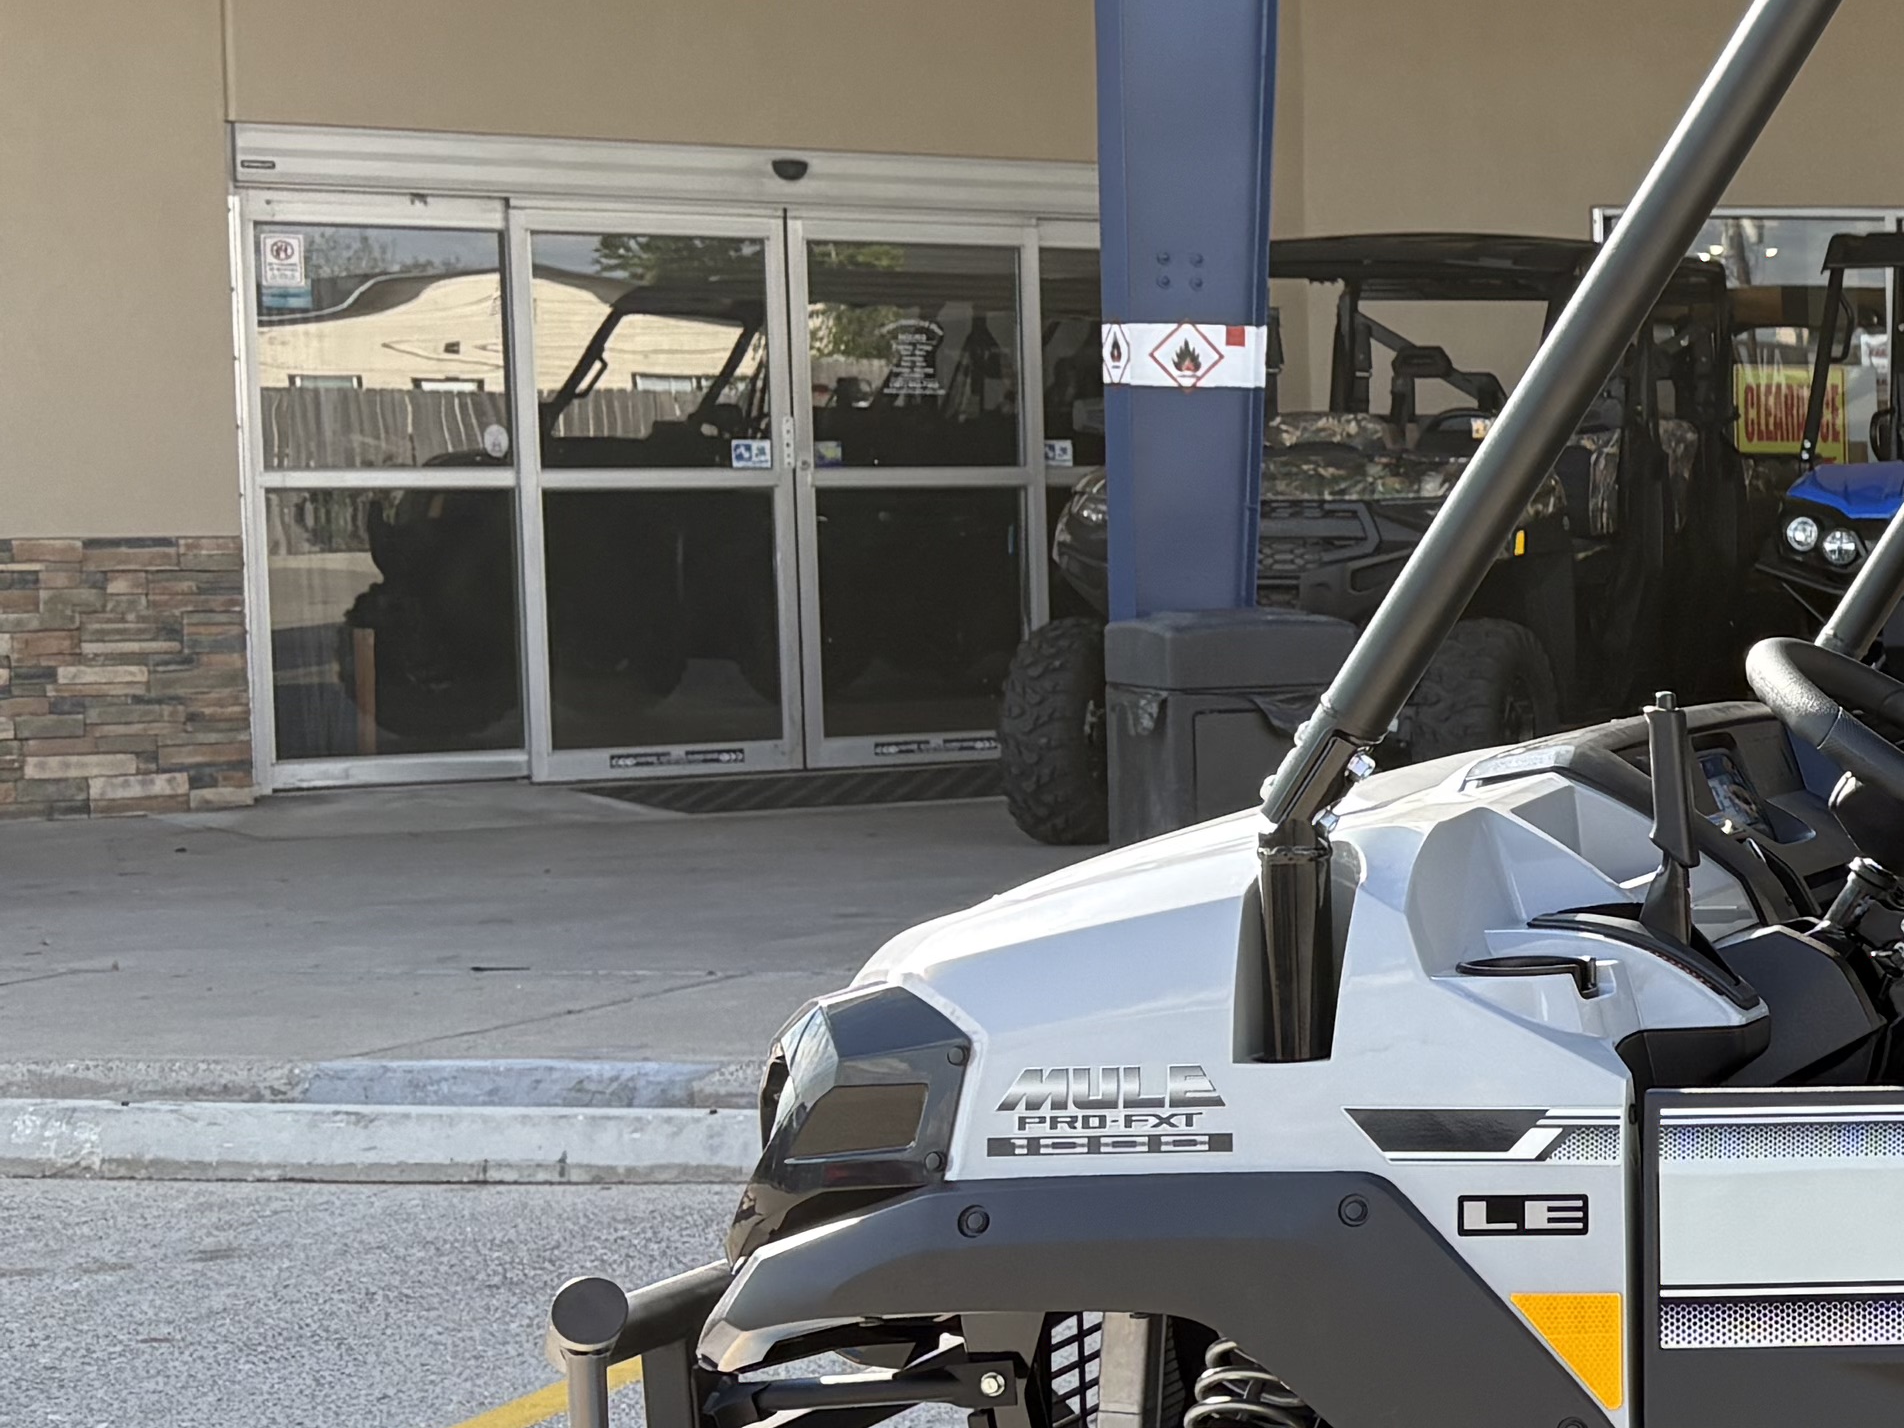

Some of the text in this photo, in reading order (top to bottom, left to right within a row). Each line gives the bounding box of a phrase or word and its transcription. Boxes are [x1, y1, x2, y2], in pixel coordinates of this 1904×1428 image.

[994, 1065, 1226, 1111] MULE
[1016, 1112, 1203, 1132] PRO-FXT
[1011, 1135, 1210, 1155] 1000
[1462, 1200, 1588, 1233] LE
